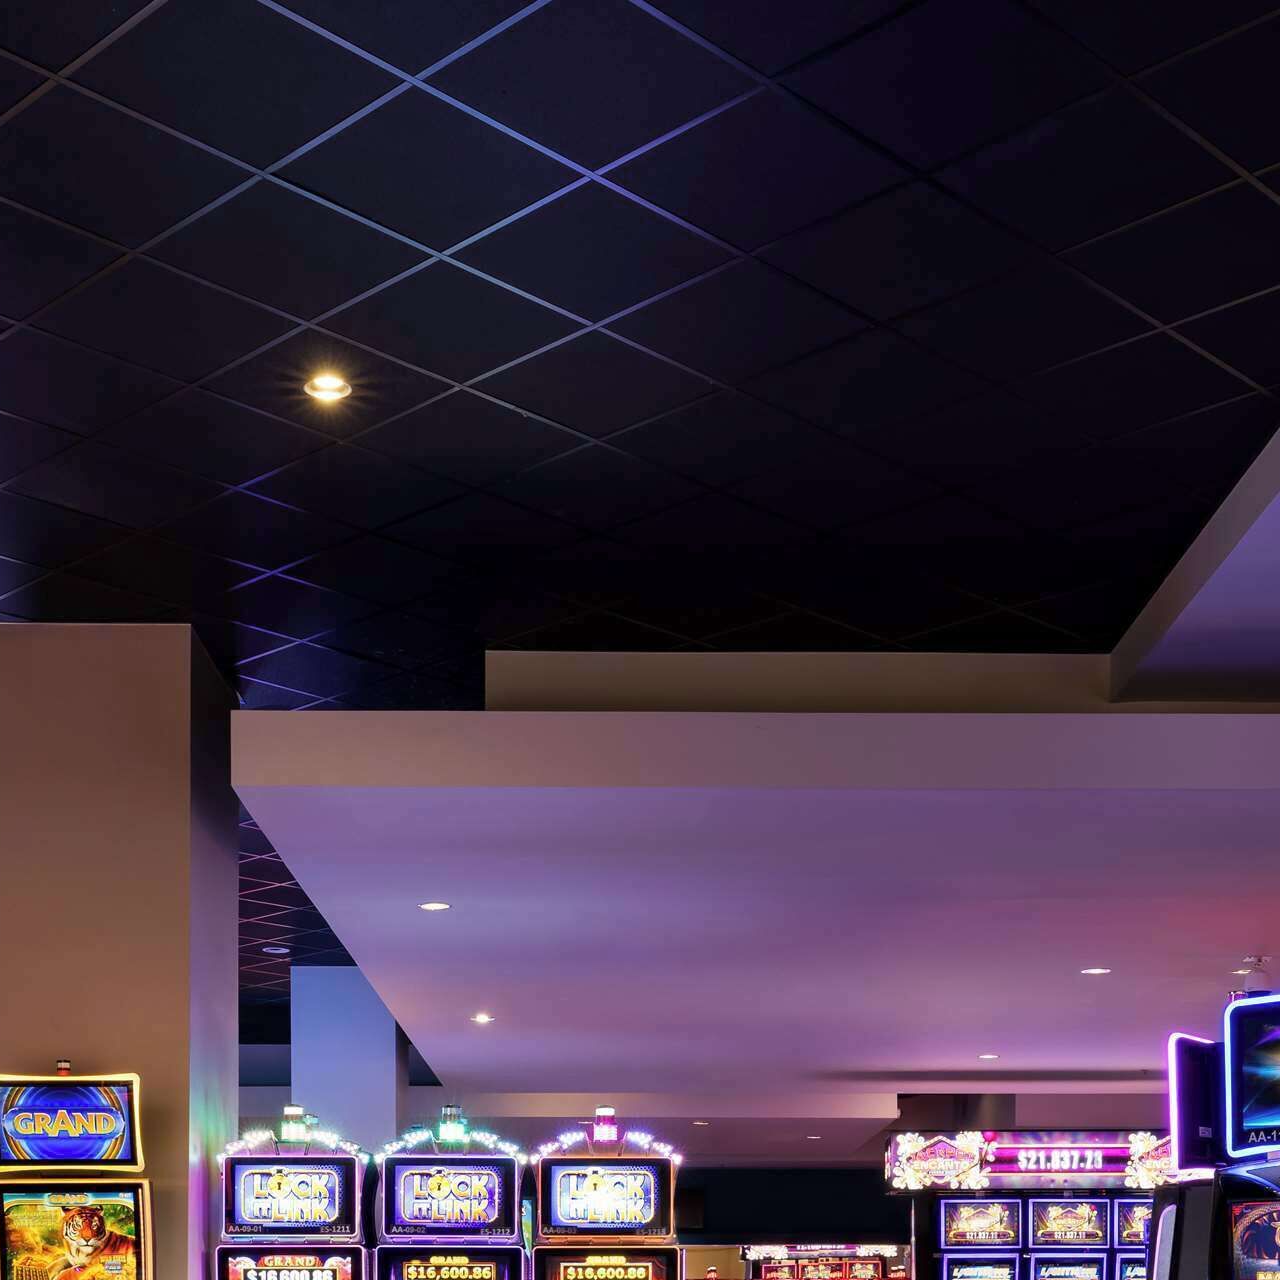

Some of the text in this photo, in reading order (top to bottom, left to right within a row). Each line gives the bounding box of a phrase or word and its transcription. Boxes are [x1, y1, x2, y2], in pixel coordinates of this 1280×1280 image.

[13, 1109, 116, 1137] GRAND
[253, 1173, 330, 1199] LOCK
[413, 1173, 489, 1199] LOCK
[271, 1200, 329, 1222] LINK
[431, 1200, 489, 1222] LINK
[228, 1225, 262, 1233] AA-09-01
[321, 1225, 351, 1233] ES-1211
[264, 1256, 316, 1267] GRAND
[407, 1266, 492, 1280] $16,600.86
